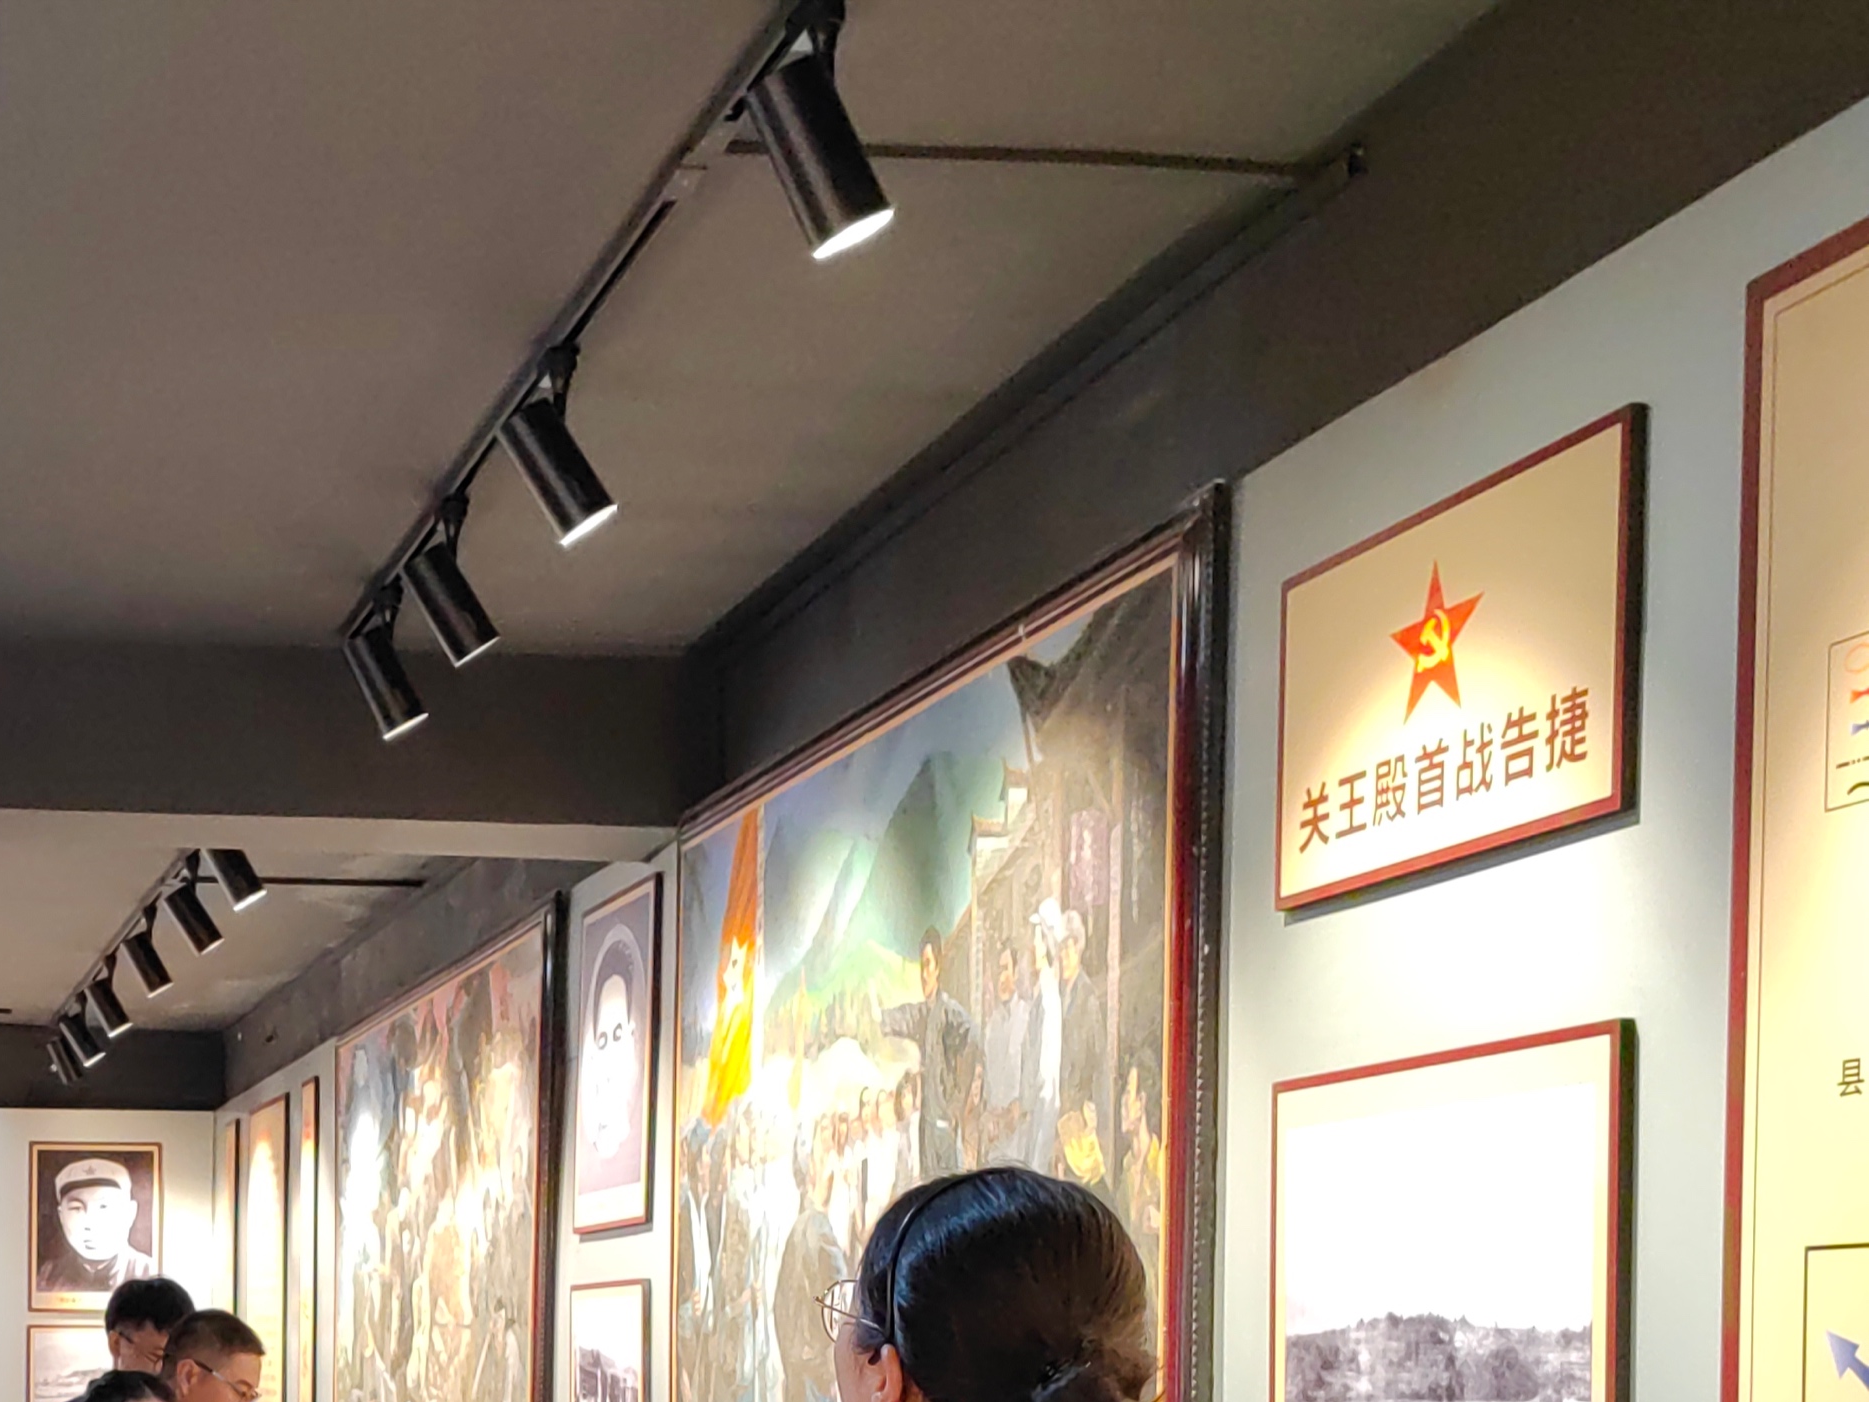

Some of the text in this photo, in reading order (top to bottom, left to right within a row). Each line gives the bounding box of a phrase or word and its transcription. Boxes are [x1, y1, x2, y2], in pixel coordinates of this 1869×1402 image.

[1299, 686, 1589, 854] 关王殿首战告捷
[1837, 1058, 1865, 1097] 县
